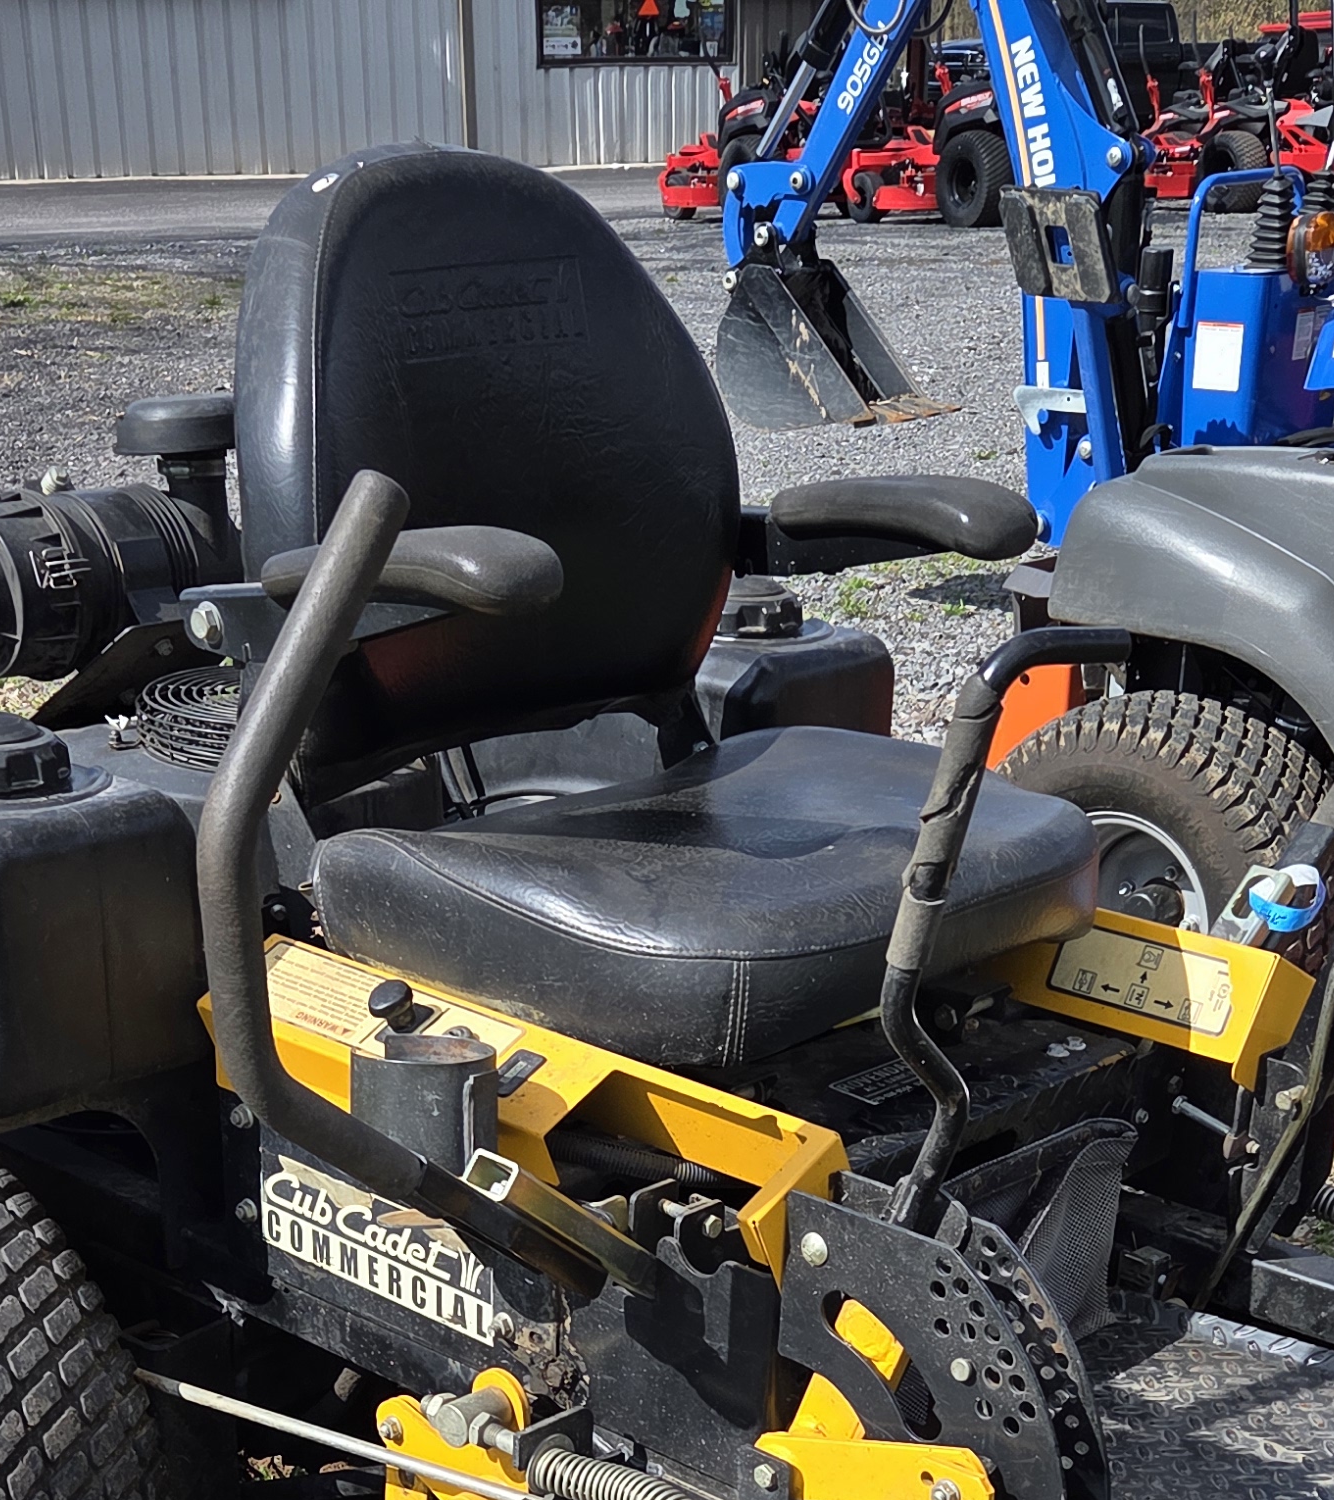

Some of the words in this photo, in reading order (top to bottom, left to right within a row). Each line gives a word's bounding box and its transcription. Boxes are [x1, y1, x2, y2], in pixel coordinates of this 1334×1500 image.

[837, 20, 888, 115] 905GB
[1011, 35, 1046, 118] NEW
[295, 1011, 345, 1035] WARNING
[264, 1172, 332, 1226] Cub
[336, 1204, 458, 1281] Cadet
[268, 1210, 488, 1338] COMMERCIAL
